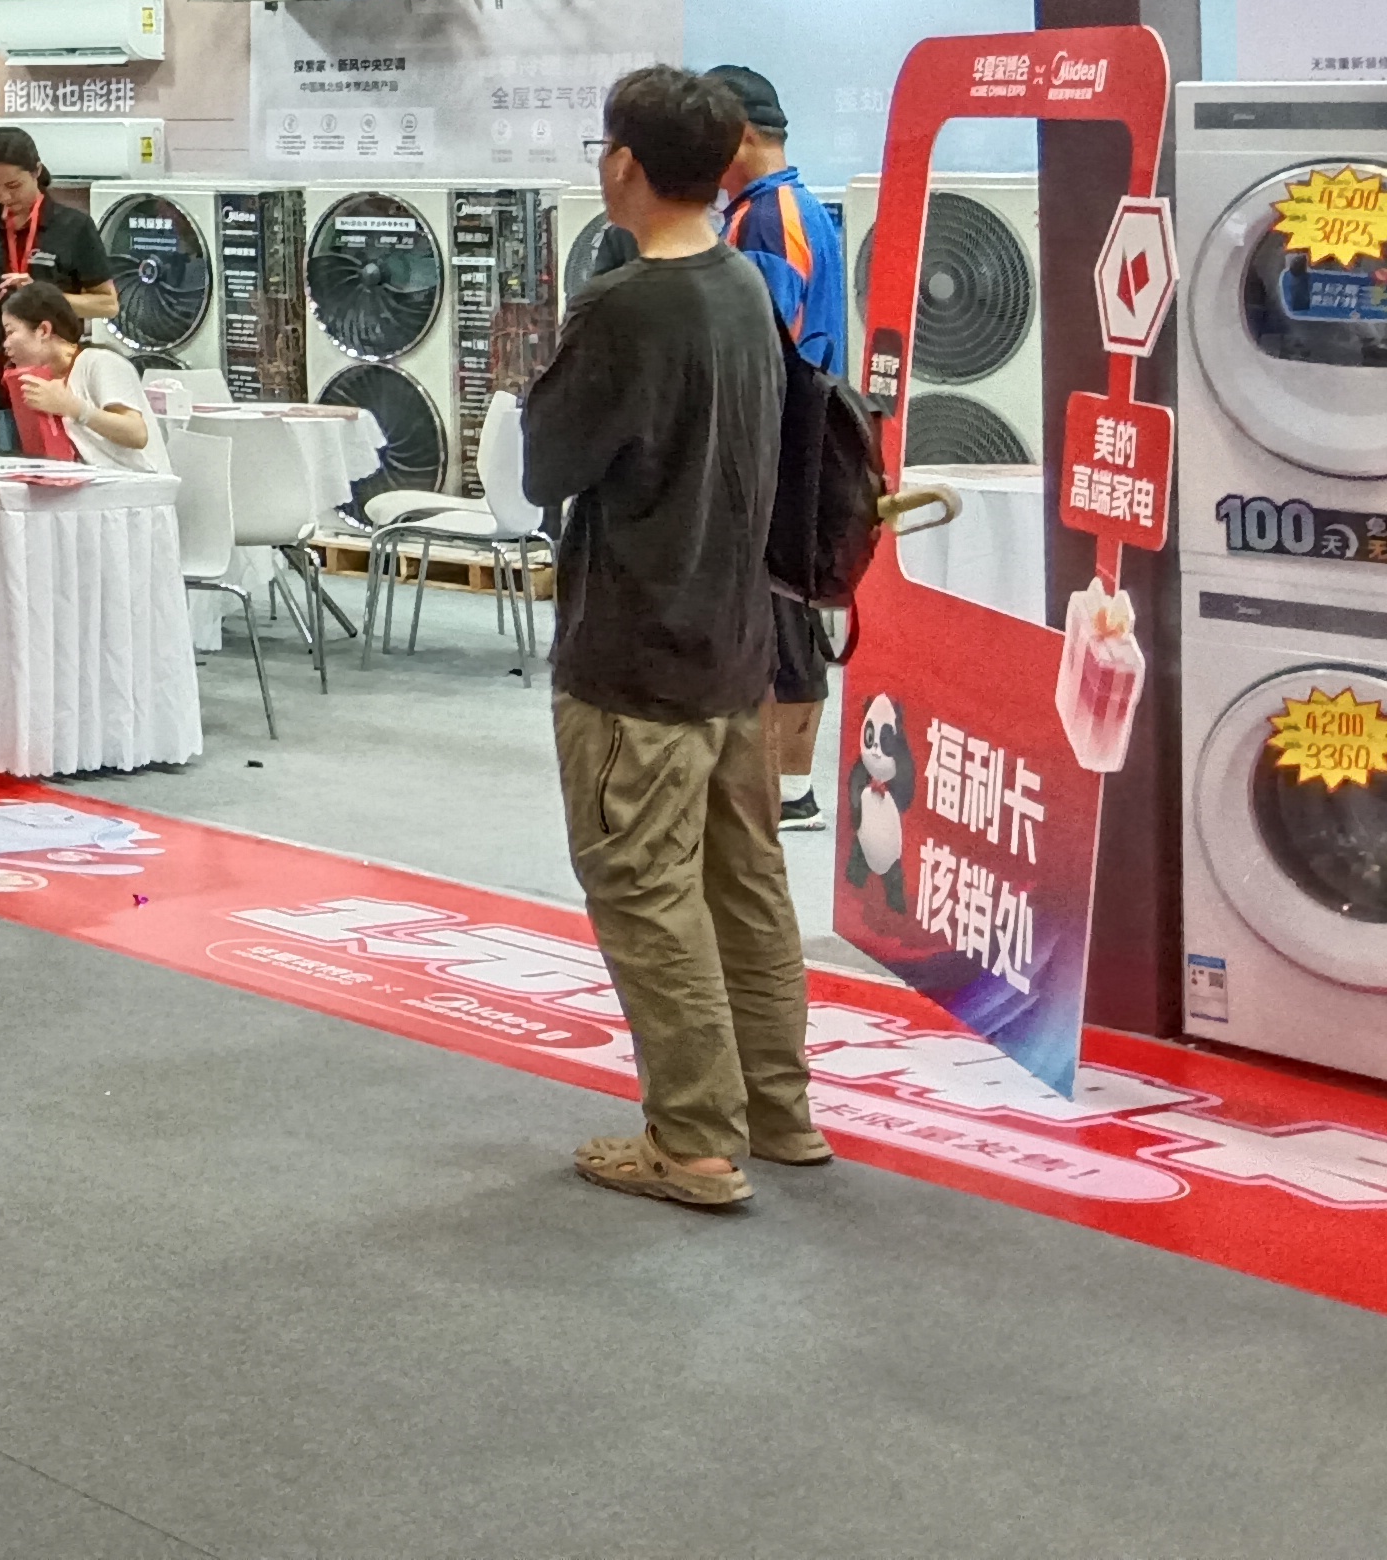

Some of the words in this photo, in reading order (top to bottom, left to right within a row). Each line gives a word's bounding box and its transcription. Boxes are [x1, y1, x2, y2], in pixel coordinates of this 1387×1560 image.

[3, 78, 136, 115] 能吸也能排
[490, 85, 610, 112] 全屋空气领
[1312, 216, 1374, 248] 3025
[1093, 415, 1137, 469] 美的
[1069, 463, 1155, 528] 高端家电
[1305, 742, 1371, 771] 3360
[924, 717, 1046, 865] 福利卡
[915, 839, 1034, 996] 核销处
